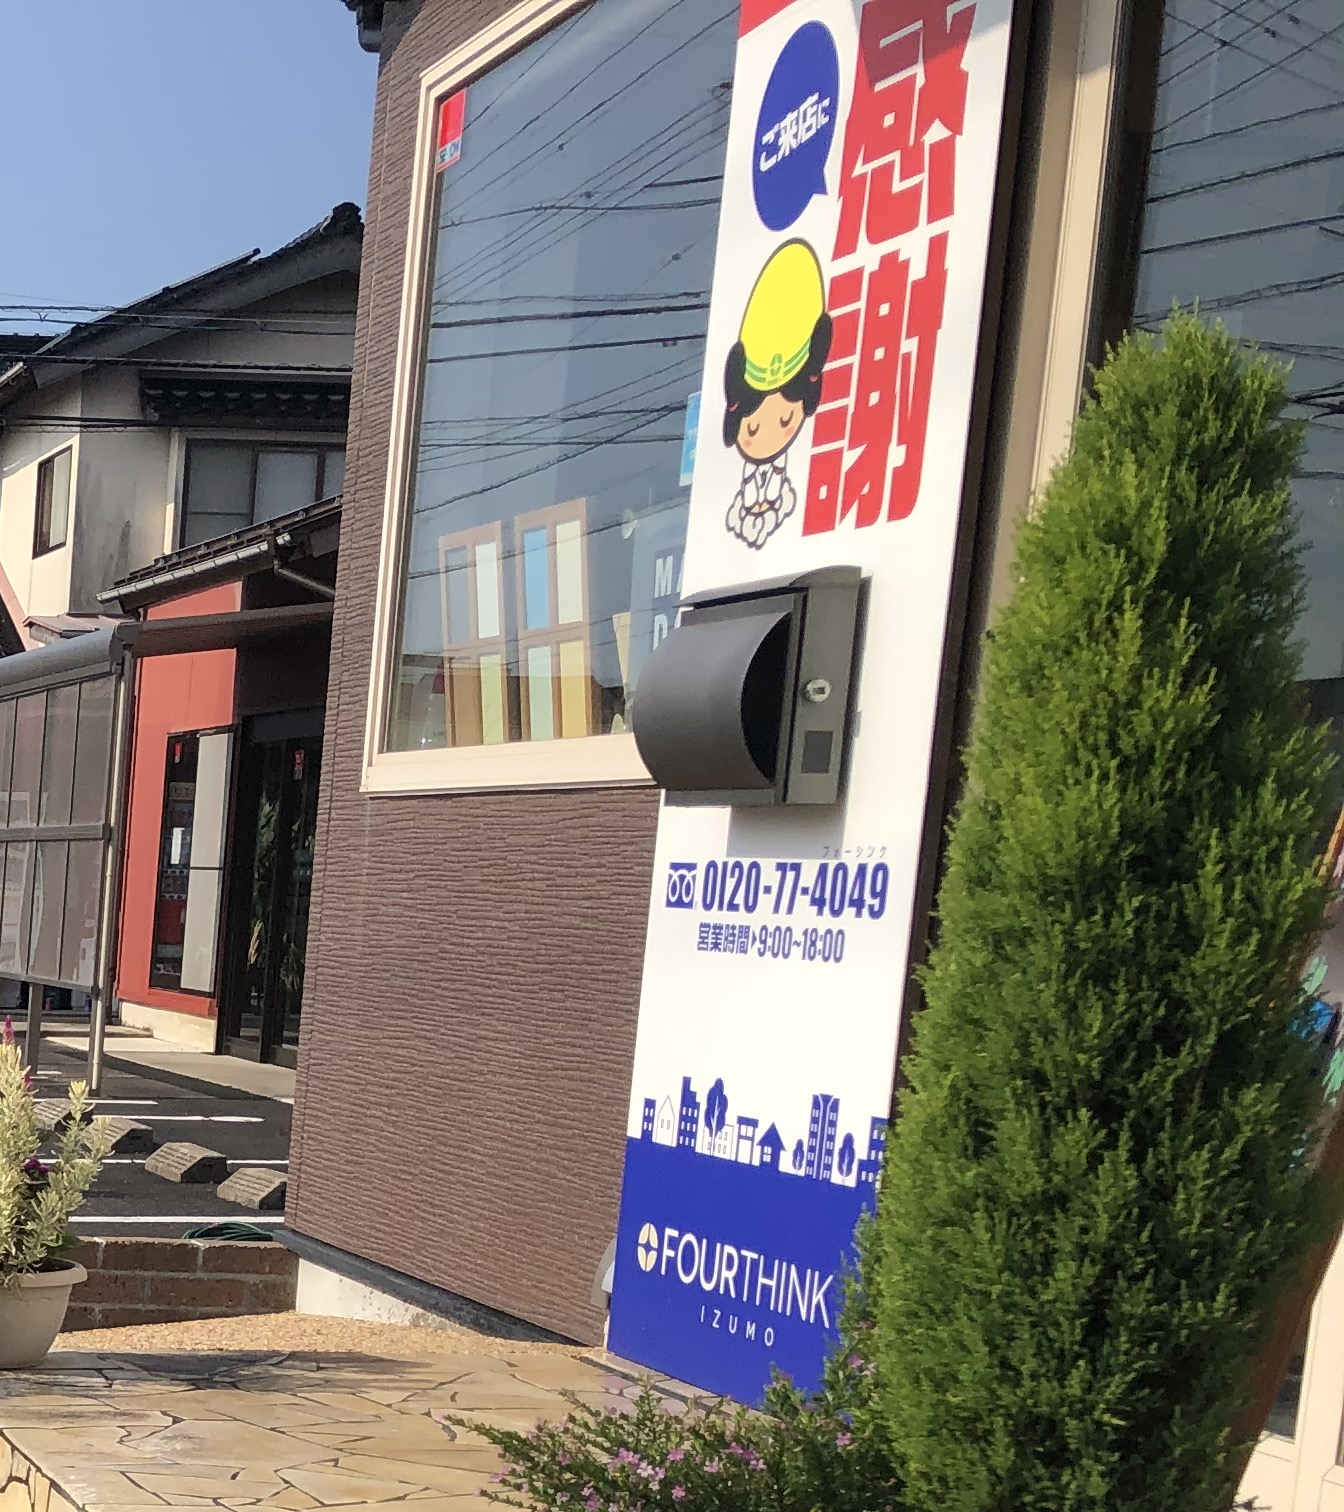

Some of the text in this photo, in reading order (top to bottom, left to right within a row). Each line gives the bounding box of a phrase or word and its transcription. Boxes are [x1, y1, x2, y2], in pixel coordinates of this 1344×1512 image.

[759, 92, 831, 172] ご来店に
[802, 0, 976, 537] 感謝
[822, 846, 888, 859] フォーシンク
[701, 860, 890, 920] 0120-77-4049
[697, 921, 751, 955] 営業時間
[661, 1226, 834, 1329] FOURTHINK
[700, 1305, 774, 1347] IZUMO
